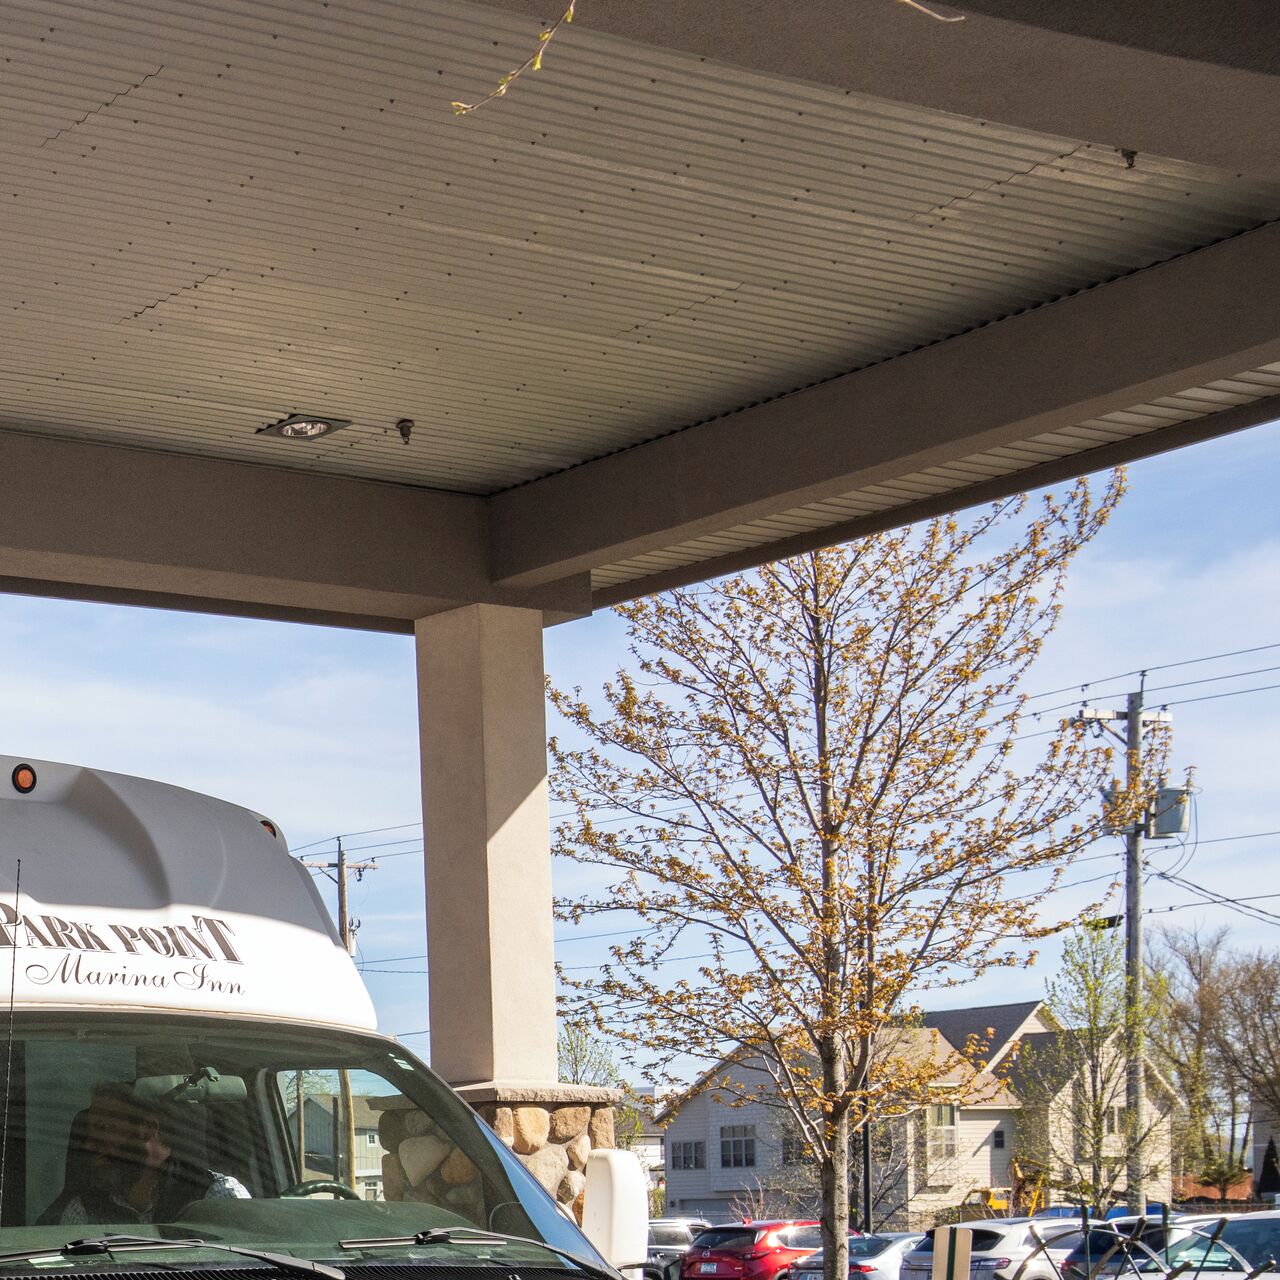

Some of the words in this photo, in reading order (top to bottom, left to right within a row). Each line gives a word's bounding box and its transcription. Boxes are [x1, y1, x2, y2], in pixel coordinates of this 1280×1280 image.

[108, 914, 244, 965] POINT
[25, 952, 170, 988] Marina
[173, 962, 245, 996] Inn
